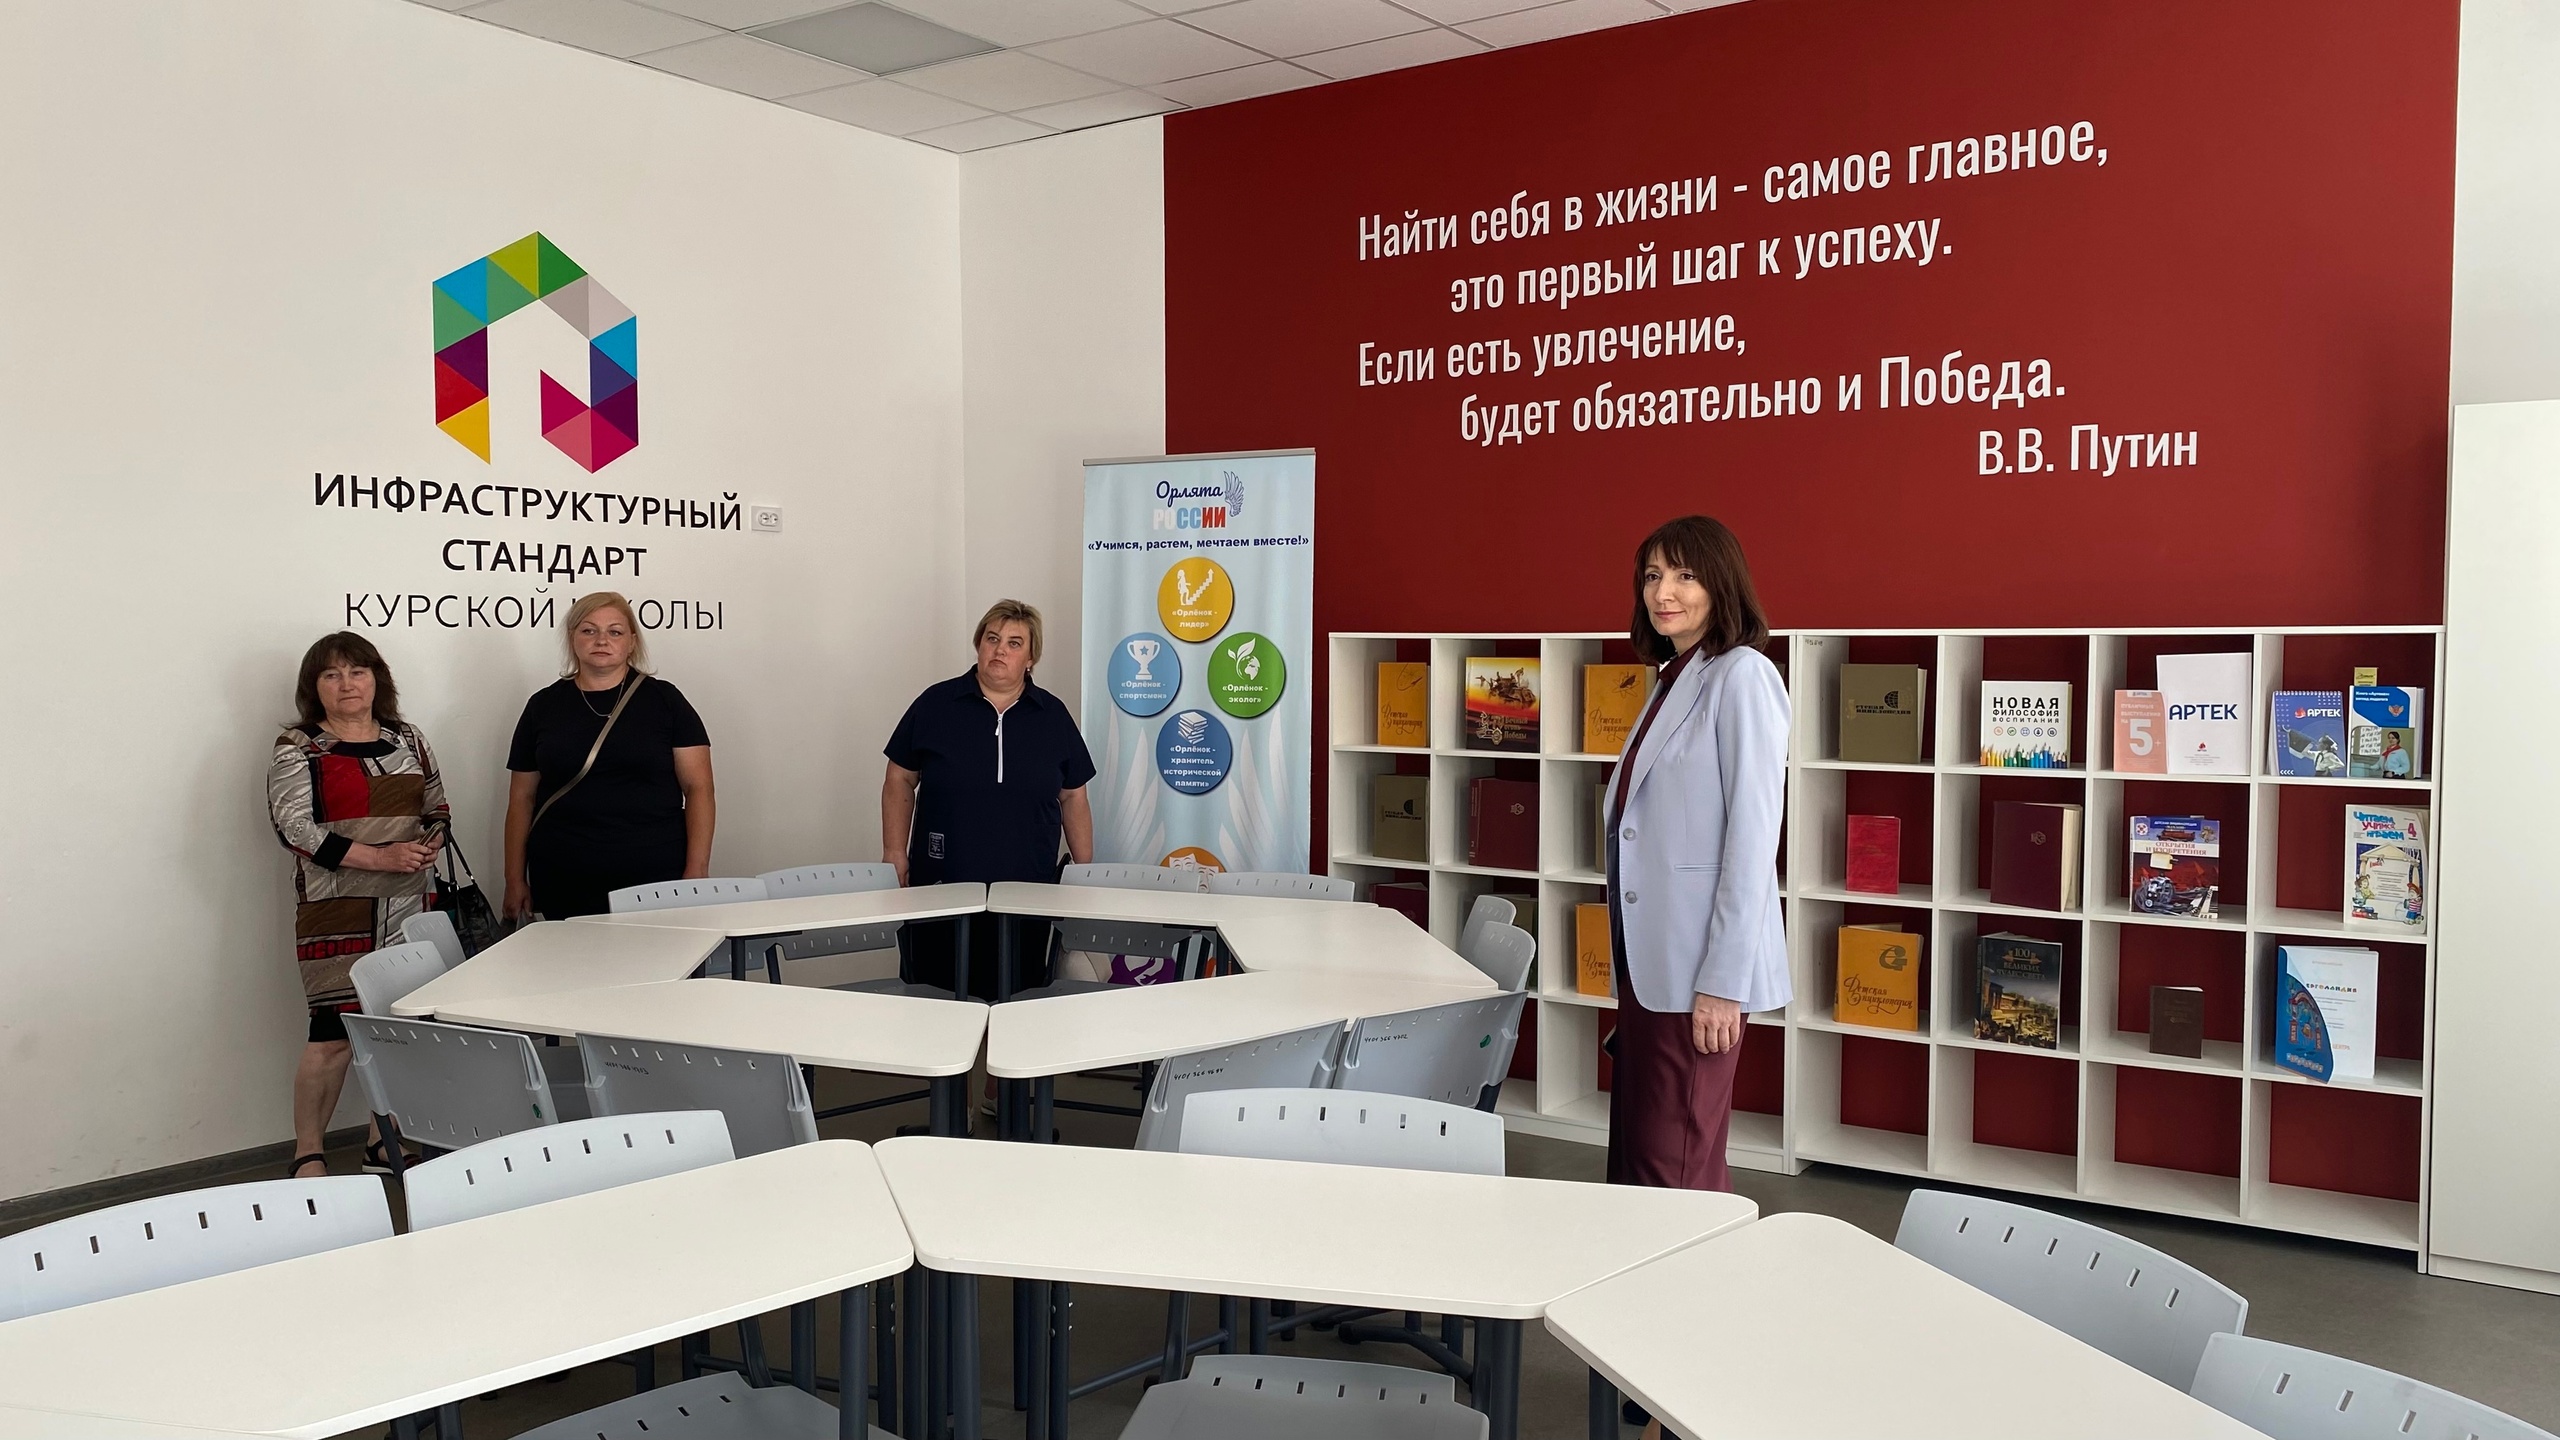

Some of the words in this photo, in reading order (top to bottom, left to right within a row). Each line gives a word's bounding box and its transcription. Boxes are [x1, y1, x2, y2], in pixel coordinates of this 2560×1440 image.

[1359, 209, 1457, 261] Найти
[1470, 190, 1550, 245] себя
[1564, 196, 1583, 232] в
[1595, 175, 1717, 228] жизни
[1733, 184, 1748, 193] -
[1764, 150, 1891, 203] самое
[1908, 120, 2108, 184] главное,
[1450, 274, 1504, 313] это
[1518, 241, 1657, 310] первый
[1672, 242, 1745, 286] шаг
[1759, 237, 1781, 276] к
[1794, 217, 1952, 280] успеху.
[1359, 341, 1434, 387] Если
[1447, 338, 1521, 378] есть
[1532, 314, 1746, 377] увлечение,
[1461, 393, 1561, 447] будет
[1573, 377, 1822, 432] обязательно
[1838, 373, 1862, 412] и
[1880, 349, 2065, 410] Победа.
[1979, 427, 2054, 476] В.В.
[2070, 423, 2198, 478] Путин
[314, 472, 741, 531] ИНФРАСТРУКТУРНЫЙ
[1156, 480, 1223, 508] Орлята
[1153, 506, 1227, 530] РОССИИ
[1088, 540, 1143, 551] «Учимся,
[1146, 539, 1193, 551] растем,
[1196, 538, 1250, 548] мечтаем
[1253, 535, 1309, 547] вместе!»
[442, 538, 647, 584] СТАНДАРТ
[346, 587, 554, 629] КУРСКОЙ
[571, 598, 723, 630] ОЛЫ
[1179, 620, 1210, 629] лидер»
[1119, 692, 1167, 701] спортсмен»
[1228, 696, 1262, 704] эколог»
[1993, 696, 2059, 709] НОВАЯ
[1992, 709, 2060, 717] ФИЛОСОФИЯ
[2169, 703, 2238, 720] АРТЕК
[2307, 708, 2341, 717] АРТЕК
[1171, 757, 1214, 766] хранитель
[1163, 768, 1222, 777] исторической
[1175, 780, 1210, 788] памяти»
[2407, 822, 2417, 837] 4
[2153, 847, 2207, 855] ИЗОБРЕТЕНИЯ
